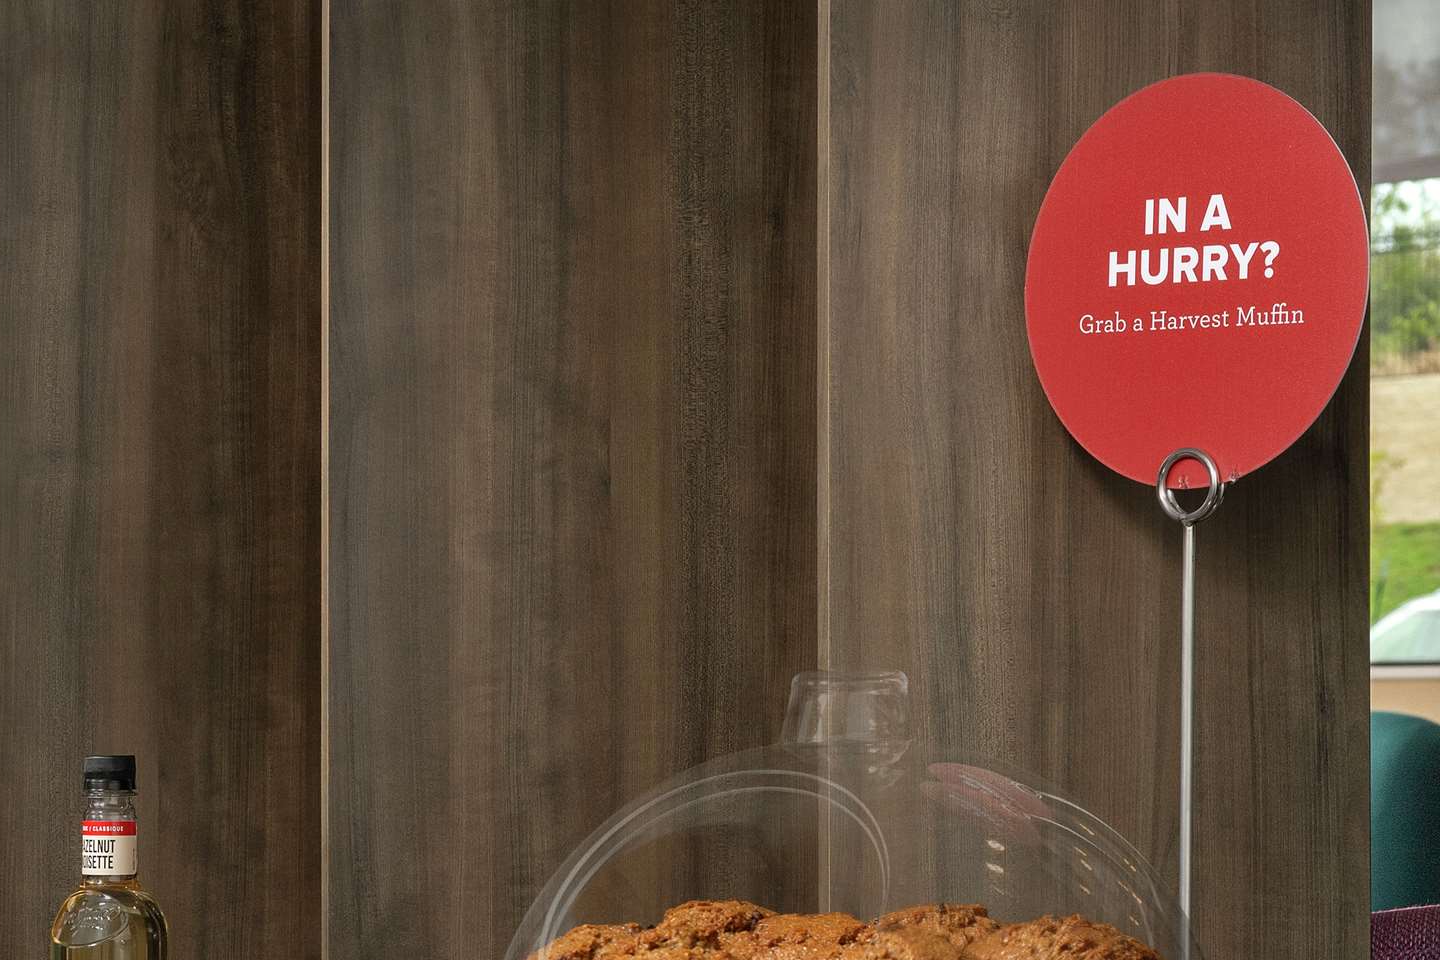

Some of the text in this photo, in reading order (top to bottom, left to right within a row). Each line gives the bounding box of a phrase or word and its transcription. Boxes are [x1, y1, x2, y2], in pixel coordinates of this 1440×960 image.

[1145, 194, 1232, 235] IN A
[1108, 241, 1280, 287] HURRY?
[1079, 303, 1305, 334] Grab a Harvest Muffin
